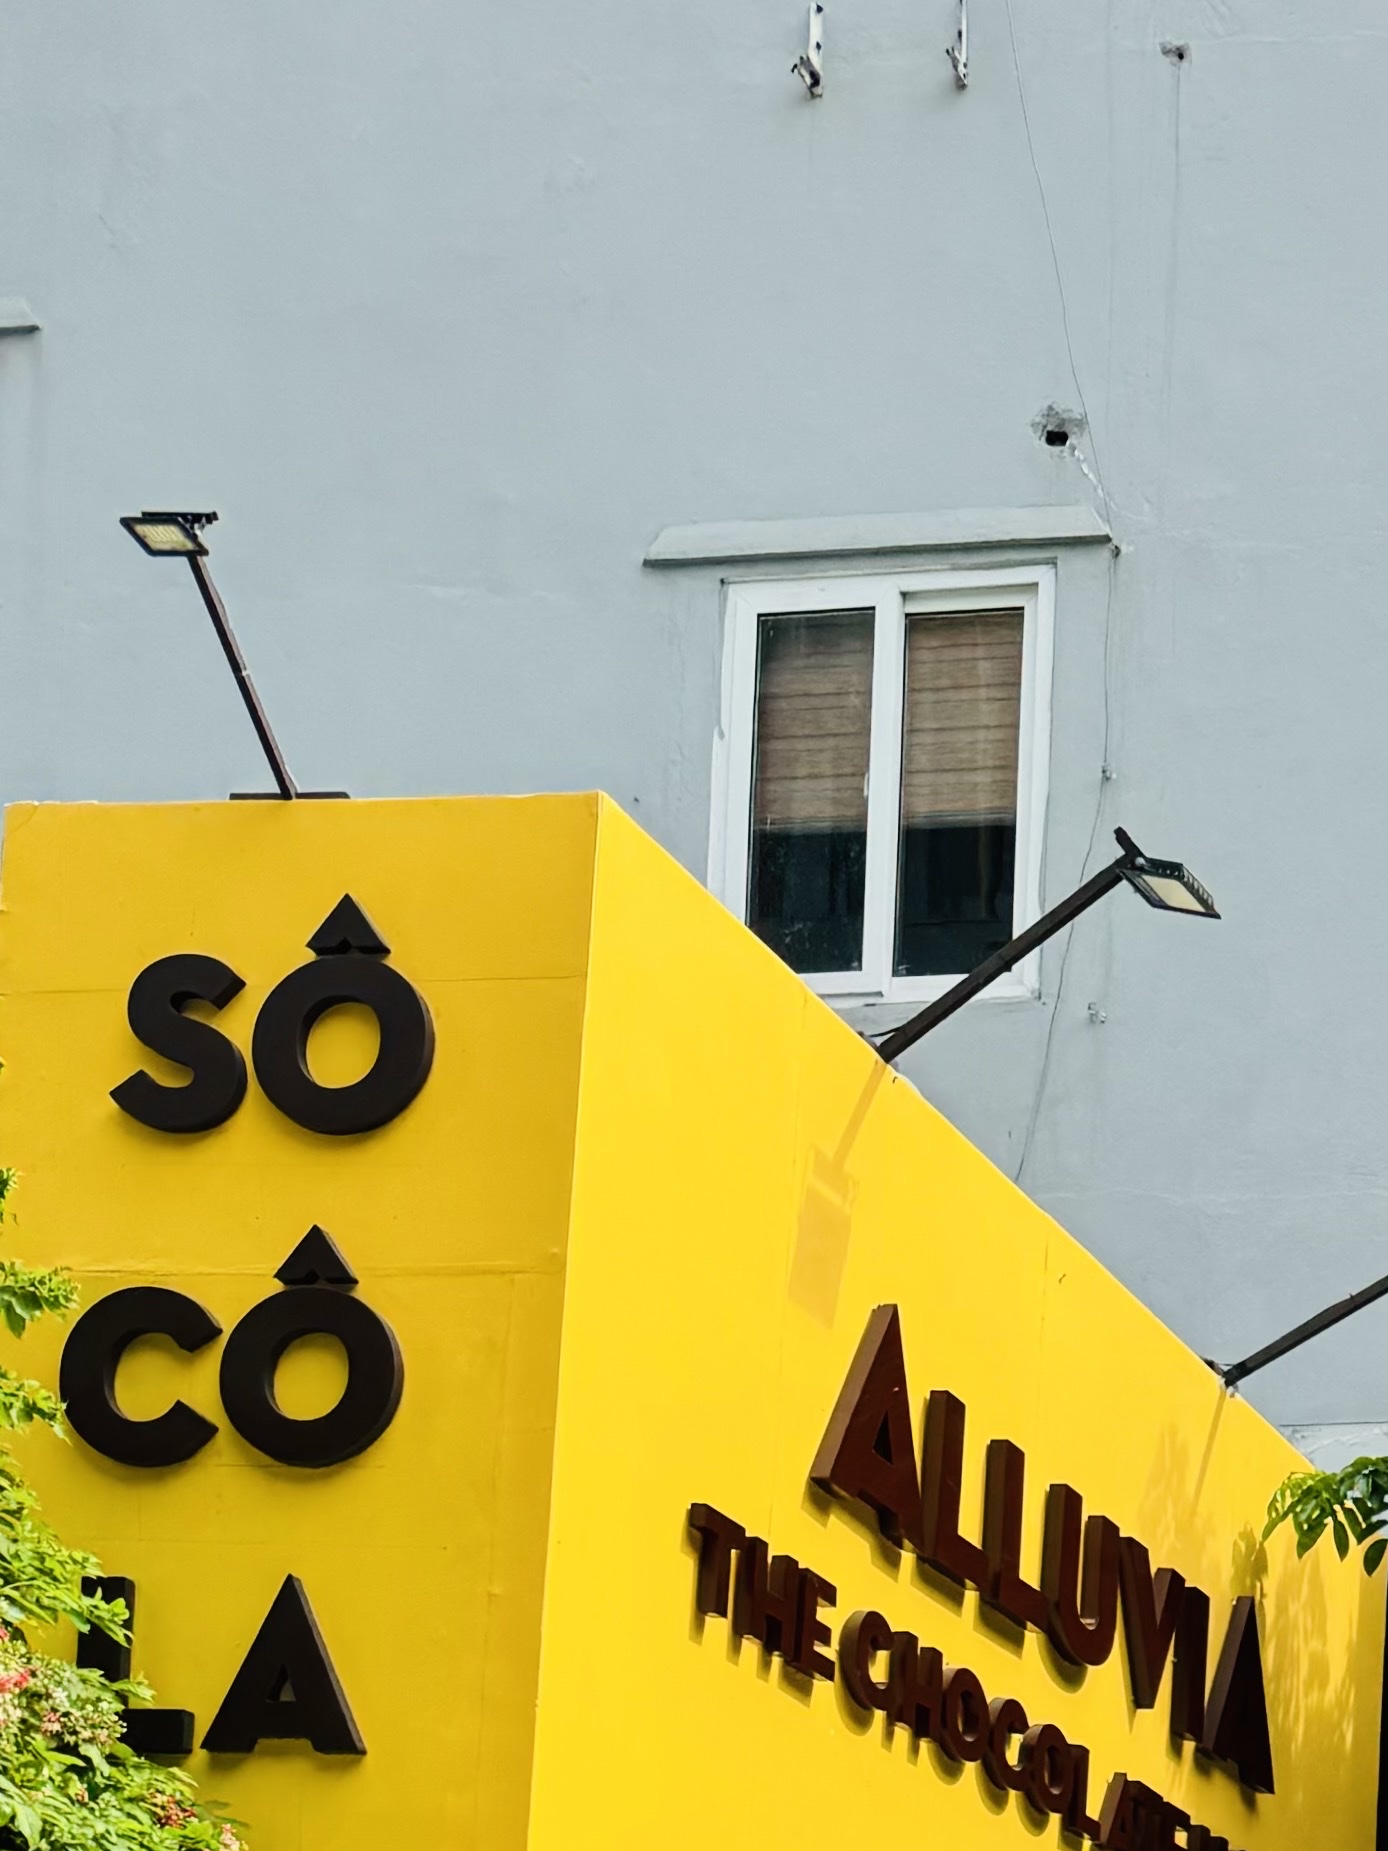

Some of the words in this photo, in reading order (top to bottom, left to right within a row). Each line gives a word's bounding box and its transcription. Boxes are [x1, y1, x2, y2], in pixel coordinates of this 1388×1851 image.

[110, 893, 436, 1136] SÔ
[59, 1224, 405, 1468] CÔ
[76, 1573, 368, 1756] LA
[689, 1502, 836, 1683] THE
[809, 1303, 1275, 1794] ALLUVIA
